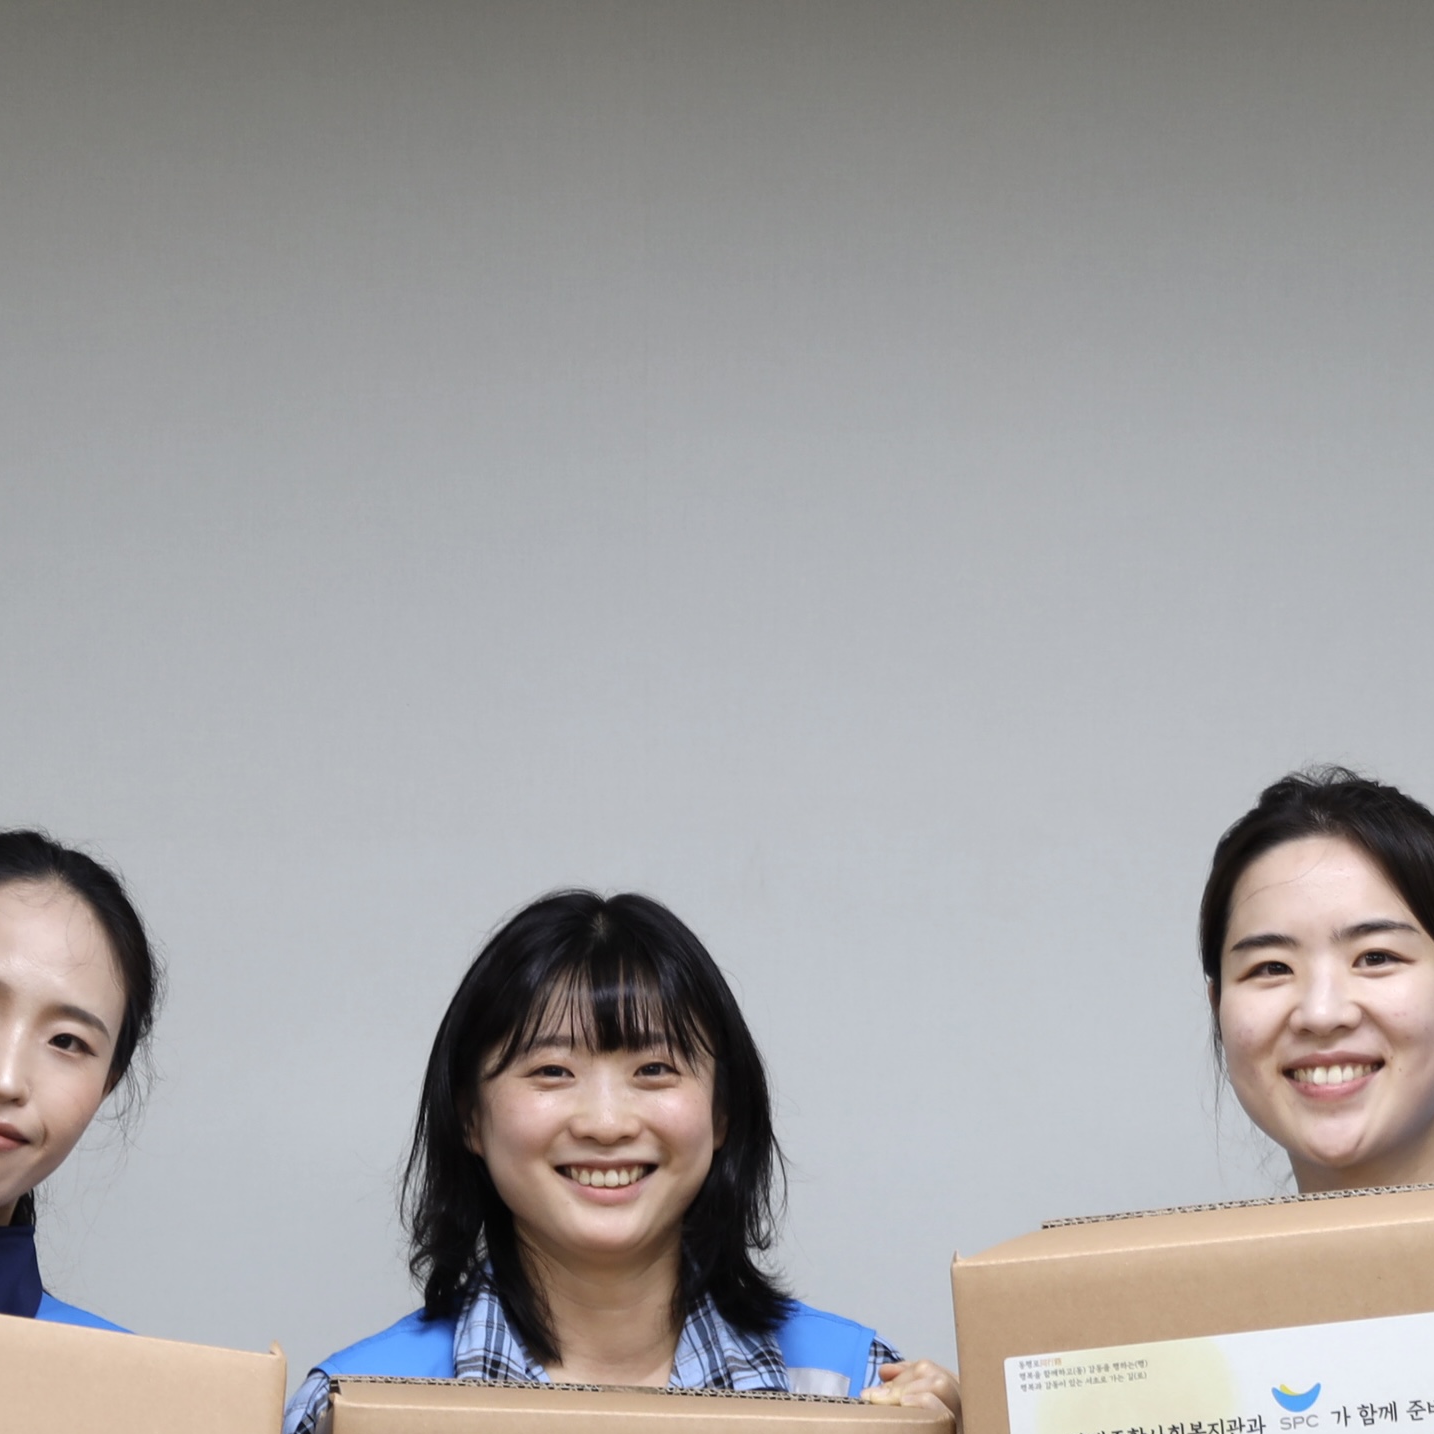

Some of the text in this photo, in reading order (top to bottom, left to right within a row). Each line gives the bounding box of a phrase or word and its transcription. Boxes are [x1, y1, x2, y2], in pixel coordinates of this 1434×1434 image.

[1279, 1414, 1319, 1431] SPC
[1331, 1406, 1351, 1427] 가
[1357, 1401, 1398, 1426] 함께
